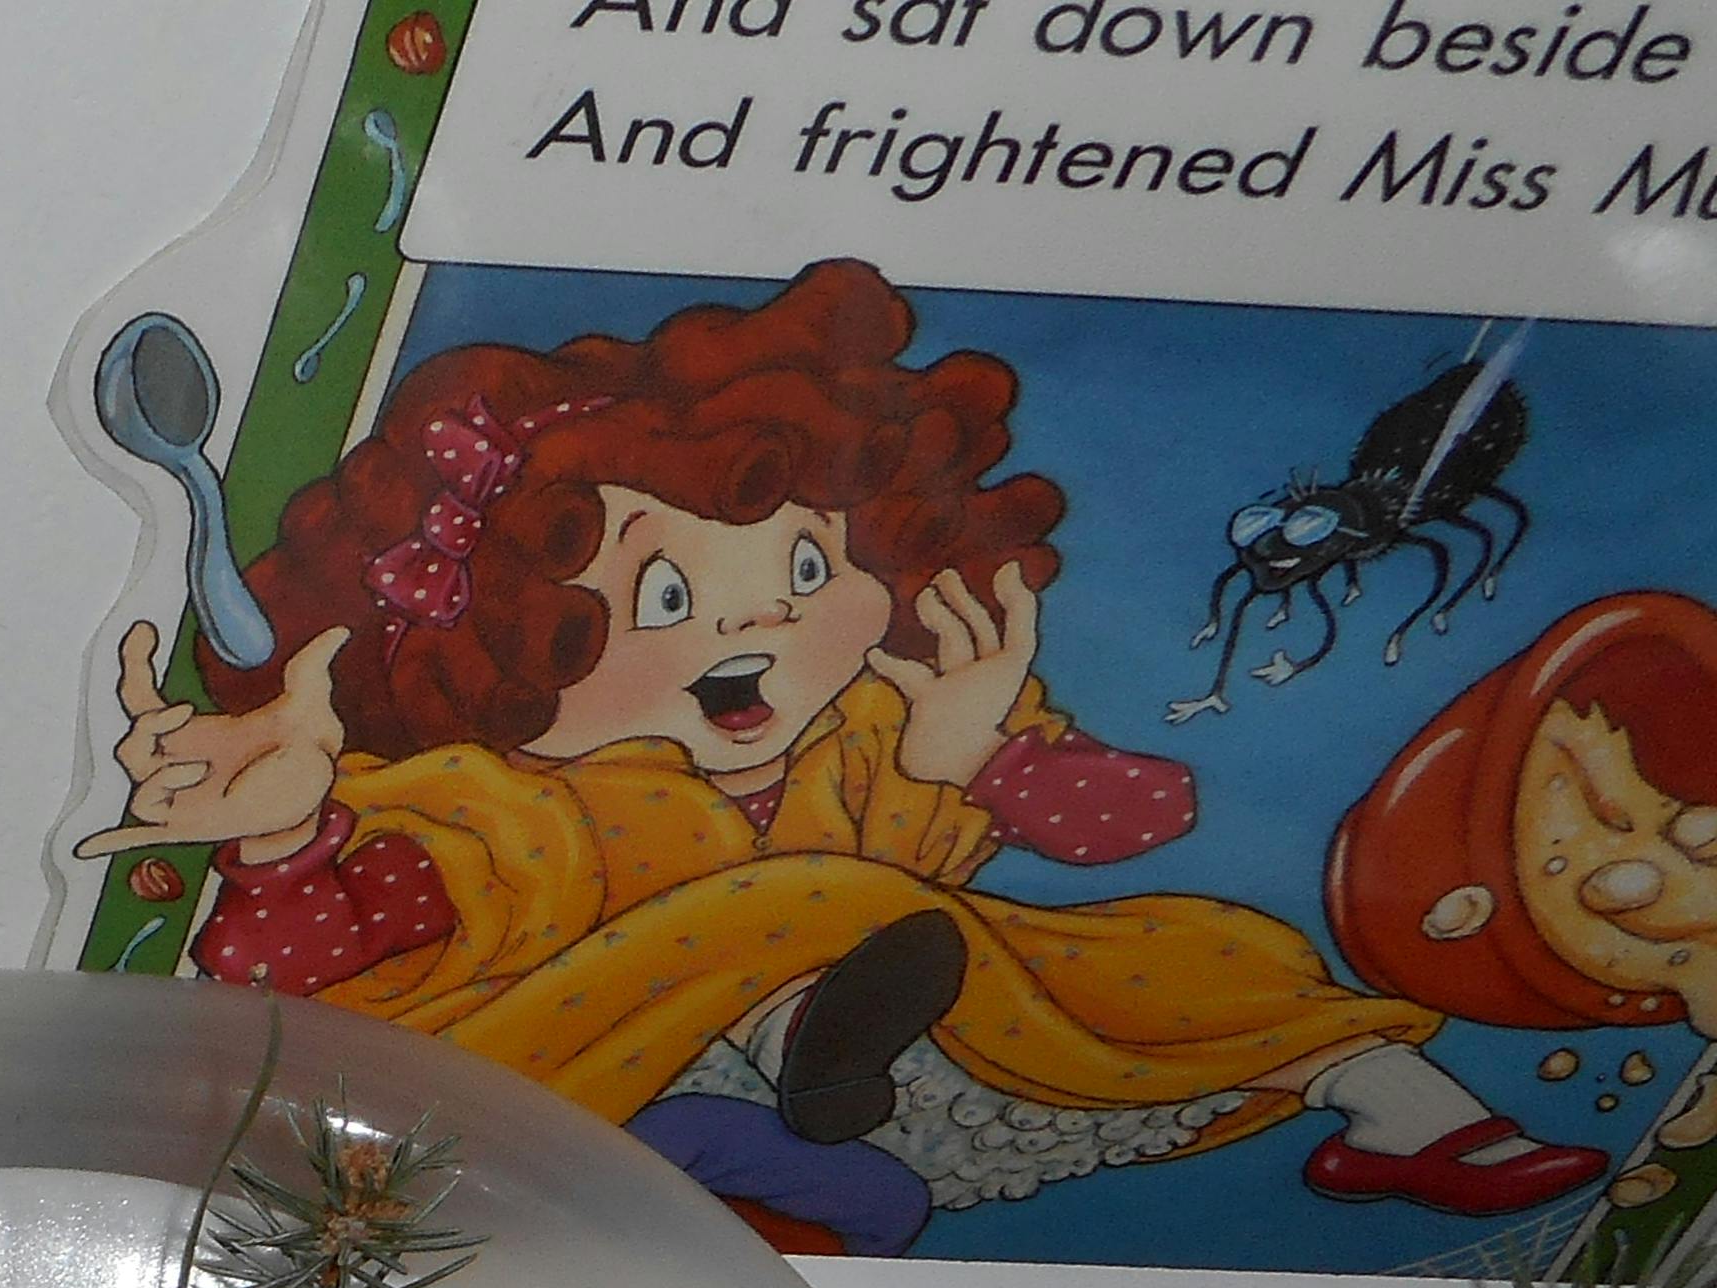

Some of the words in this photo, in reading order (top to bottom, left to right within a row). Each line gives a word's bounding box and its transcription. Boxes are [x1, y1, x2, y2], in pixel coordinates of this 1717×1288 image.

[841, 0, 990, 47] sat
[1034, 0, 1314, 65] down
[1361, 0, 1692, 84] beside
[525, 89, 753, 170] And
[794, 101, 1319, 203] frightened
[1339, 130, 1558, 212] Miss
